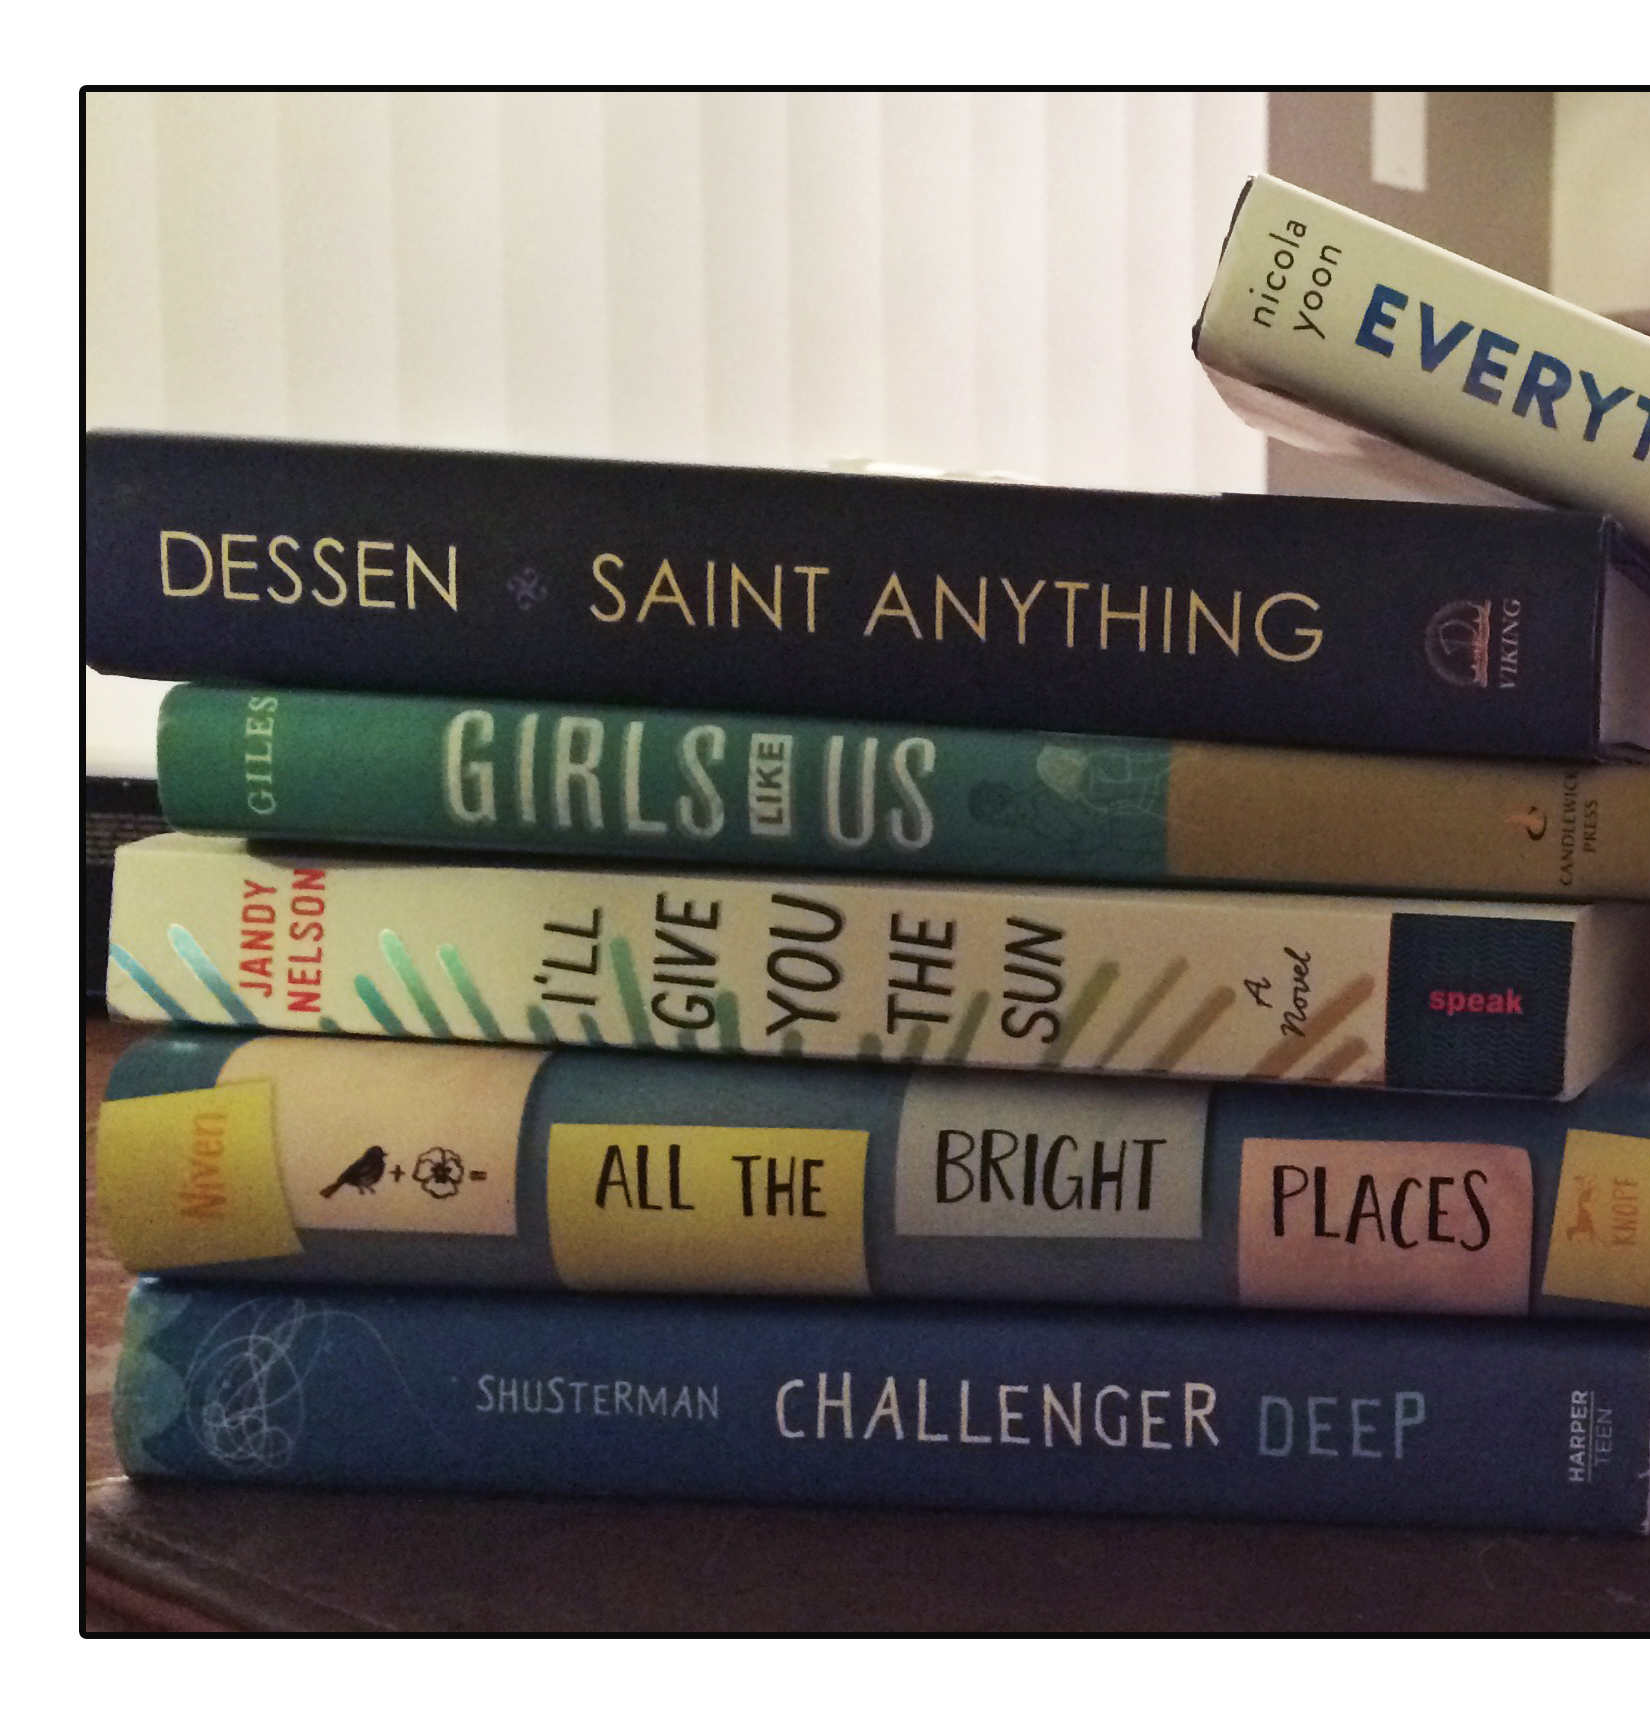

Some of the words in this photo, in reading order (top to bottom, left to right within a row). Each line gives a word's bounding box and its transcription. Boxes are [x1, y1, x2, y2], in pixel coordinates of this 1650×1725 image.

[1253, 218, 1307, 328] nicola
[1293, 244, 1341, 339] yoon
[159, 529, 459, 612] DESSEN
[590, 552, 830, 634] SAINT
[863, 571, 1324, 663] ANYTHING
[1499, 599, 1521, 689] VIKING
[246, 696, 278, 815] GILES
[443, 708, 726, 842] GIRLS
[757, 740, 786, 826] LIKE
[826, 737, 937, 851] US
[1559, 768, 1579, 886] CANDLEWICK
[1583, 799, 1598, 853] PRESS
[239, 879, 278, 998] JANDY
[287, 868, 326, 1013] NELSON
[533, 907, 602, 1006] I'LL
[650, 891, 720, 1031] GIVE
[765, 892, 846, 1036] YOU
[887, 911, 956, 1035] THE
[1000, 914, 1066, 1045] SUN
[1243, 976, 1275, 1010] A
[1280, 946, 1312, 1038] Novel
[1428, 985, 1524, 1018] speak
[595, 1143, 696, 1212] ALL
[731, 1154, 827, 1219] THE
[934, 1128, 1168, 1213] BRIGHT
[1271, 1164, 1492, 1253] PLACES
[1609, 1176, 1639, 1246] KNOPF
[475, 1374, 719, 1420] SHUSTERMAN
[775, 1371, 1220, 1450] CHALLENGER
[1258, 1392, 1425, 1460] DEEP
[1569, 1390, 1588, 1483] HARPER
[1595, 1408, 1613, 1467] TEEN
